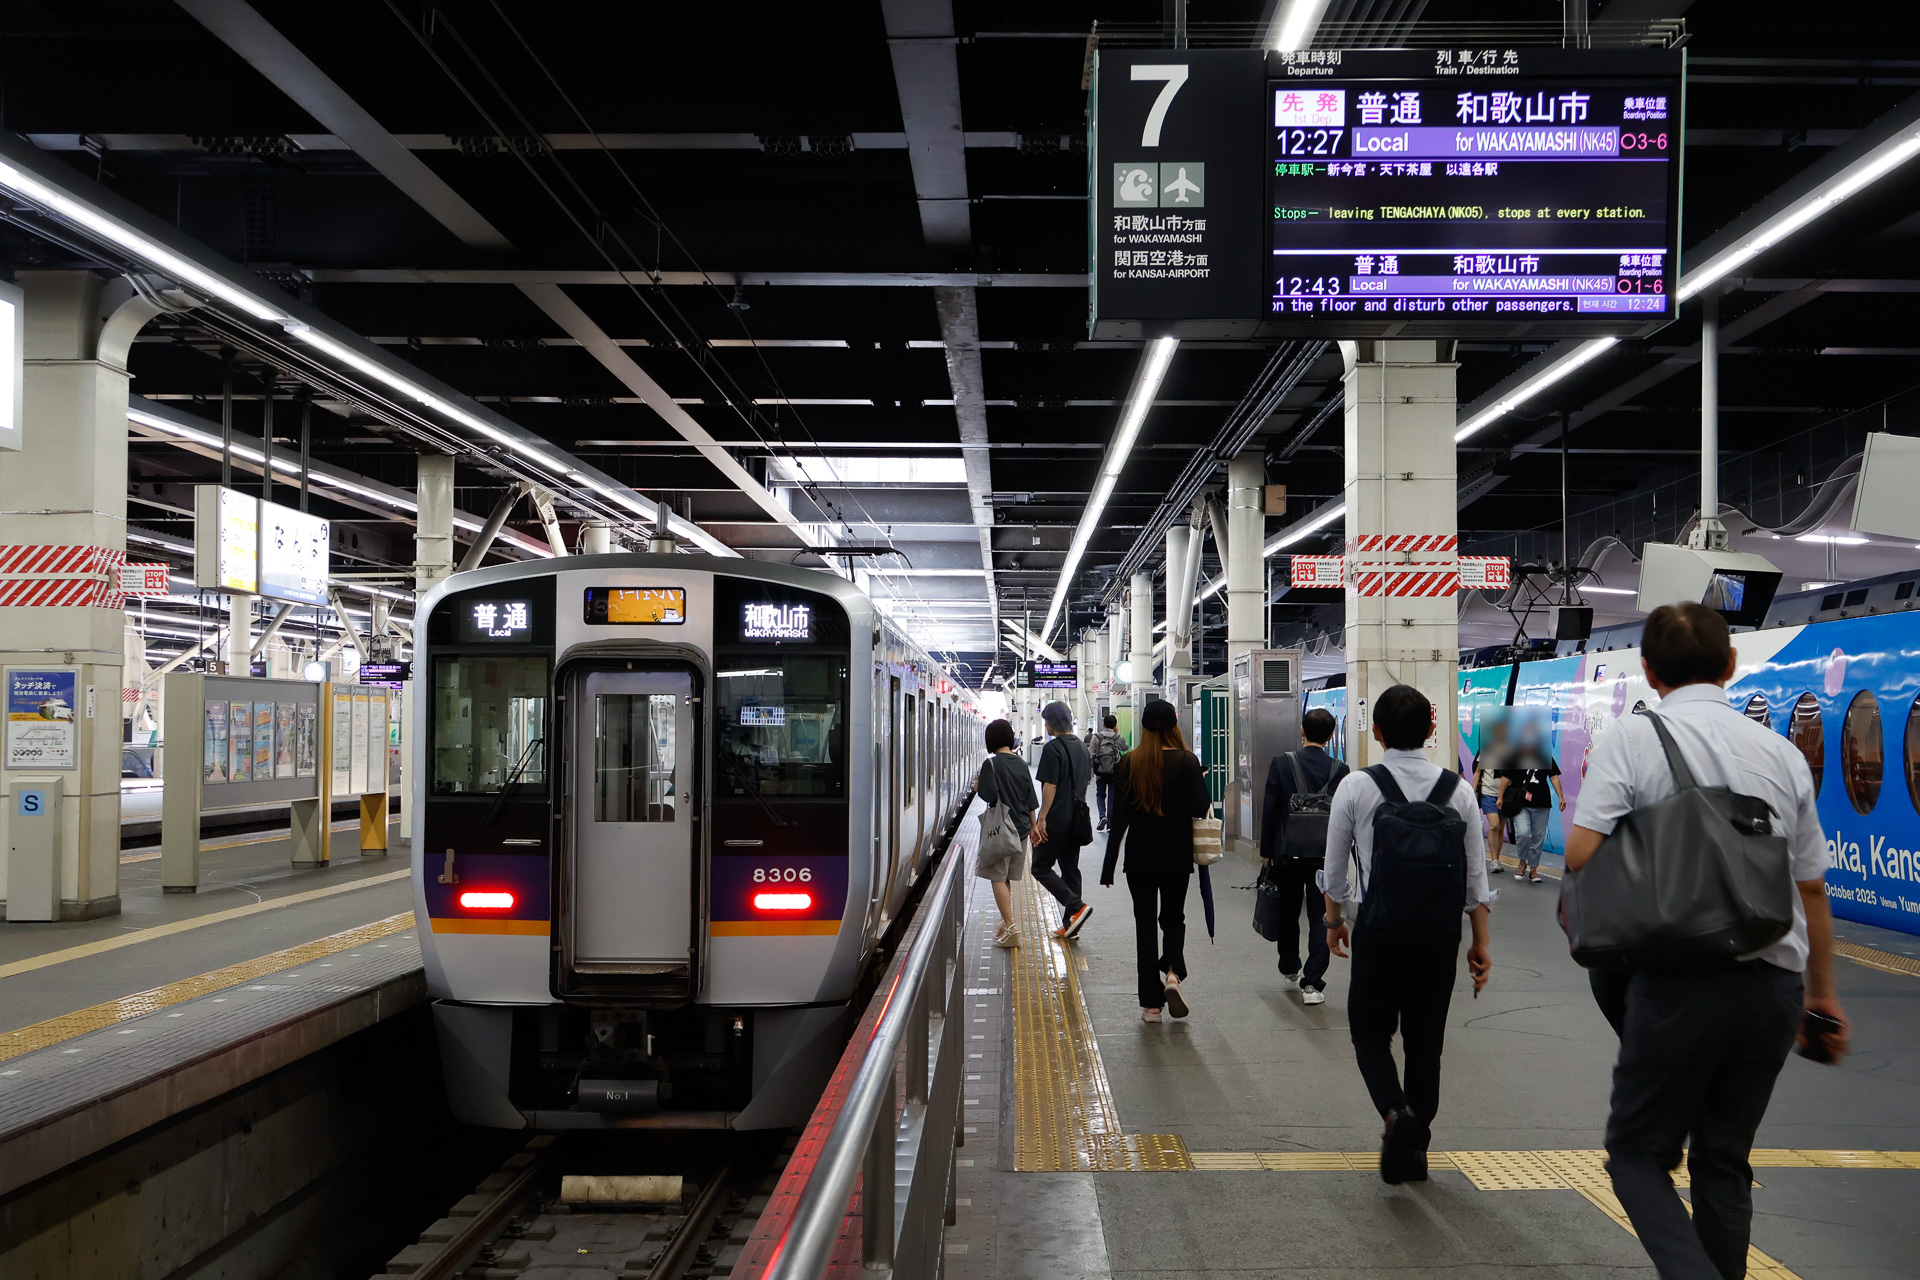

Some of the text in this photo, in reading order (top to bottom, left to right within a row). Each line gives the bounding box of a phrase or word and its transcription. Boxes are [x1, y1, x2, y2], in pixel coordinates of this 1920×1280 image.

[1282, 50, 1342, 65] 発車時刻
[1288, 66, 1334, 76] Departure
[1434, 66, 1457, 74] Train
[1467, 66, 1519, 74] Destination
[1131, 64, 1188, 146] 7
[1356, 91, 1590, 124] 普通 和歌山市
[1624, 97, 1666, 110] 乗車位置
[1293, 114, 1332, 126] 1st. Dep
[1623, 111, 1666, 120] Boarding Position
[1277, 130, 1343, 155] 12:27
[1356, 129, 1617, 153] Local for WAKAYAMASHI (NK45)
[1446, 162, 1498, 176] 以遠各駅
[1329, 206, 1374, 220] leaving
[1498, 207, 1531, 220] stops
[1538, 207, 1550, 219] at
[1557, 208, 1590, 220] every
[1596, 206, 1646, 218] station.
[1114, 215, 1206, 231] 和歌山市方面
[1114, 234, 1202, 243] for WAKAYAMASHI
[1114, 250, 1208, 266] 関西空港方面
[1354, 255, 1540, 275] 普通 和歌山市
[1619, 255, 1662, 268] 乗車位置
[1114, 269, 1210, 278] for KANSAI-AIRPORT
[1619, 268, 1640, 277] Boarding
[1276, 277, 1340, 295] 12:43
[1352, 277, 1612, 292] Local for WAKAYAMASHI (NK45)
[1291, 298, 1313, 311] the
[1321, 298, 1356, 311] floor
[1364, 298, 1386, 311] and
[1394, 298, 1445, 311] disturb
[1452, 299, 1489, 311] other
[1496, 300, 1574, 312] passengers.
[1583, 300, 1617, 309] 현재 시간
[1628, 299, 1659, 310] 12:24
[474, 603, 527, 628] 普通
[745, 604, 810, 629] 和歌山市
[489, 628, 511, 636] Local
[745, 629, 808, 638] WAKAYAMASHI
[210, 662, 216, 671] 5
[1020, 662, 1026, 671] 7
[24, 795, 38, 811] S
[988, 826, 1000, 839] HAY
[753, 868, 812, 882] 8306
[1824, 882, 1920, 914] October 2025 Venue Yum
[606, 1091, 628, 1100] No.1
